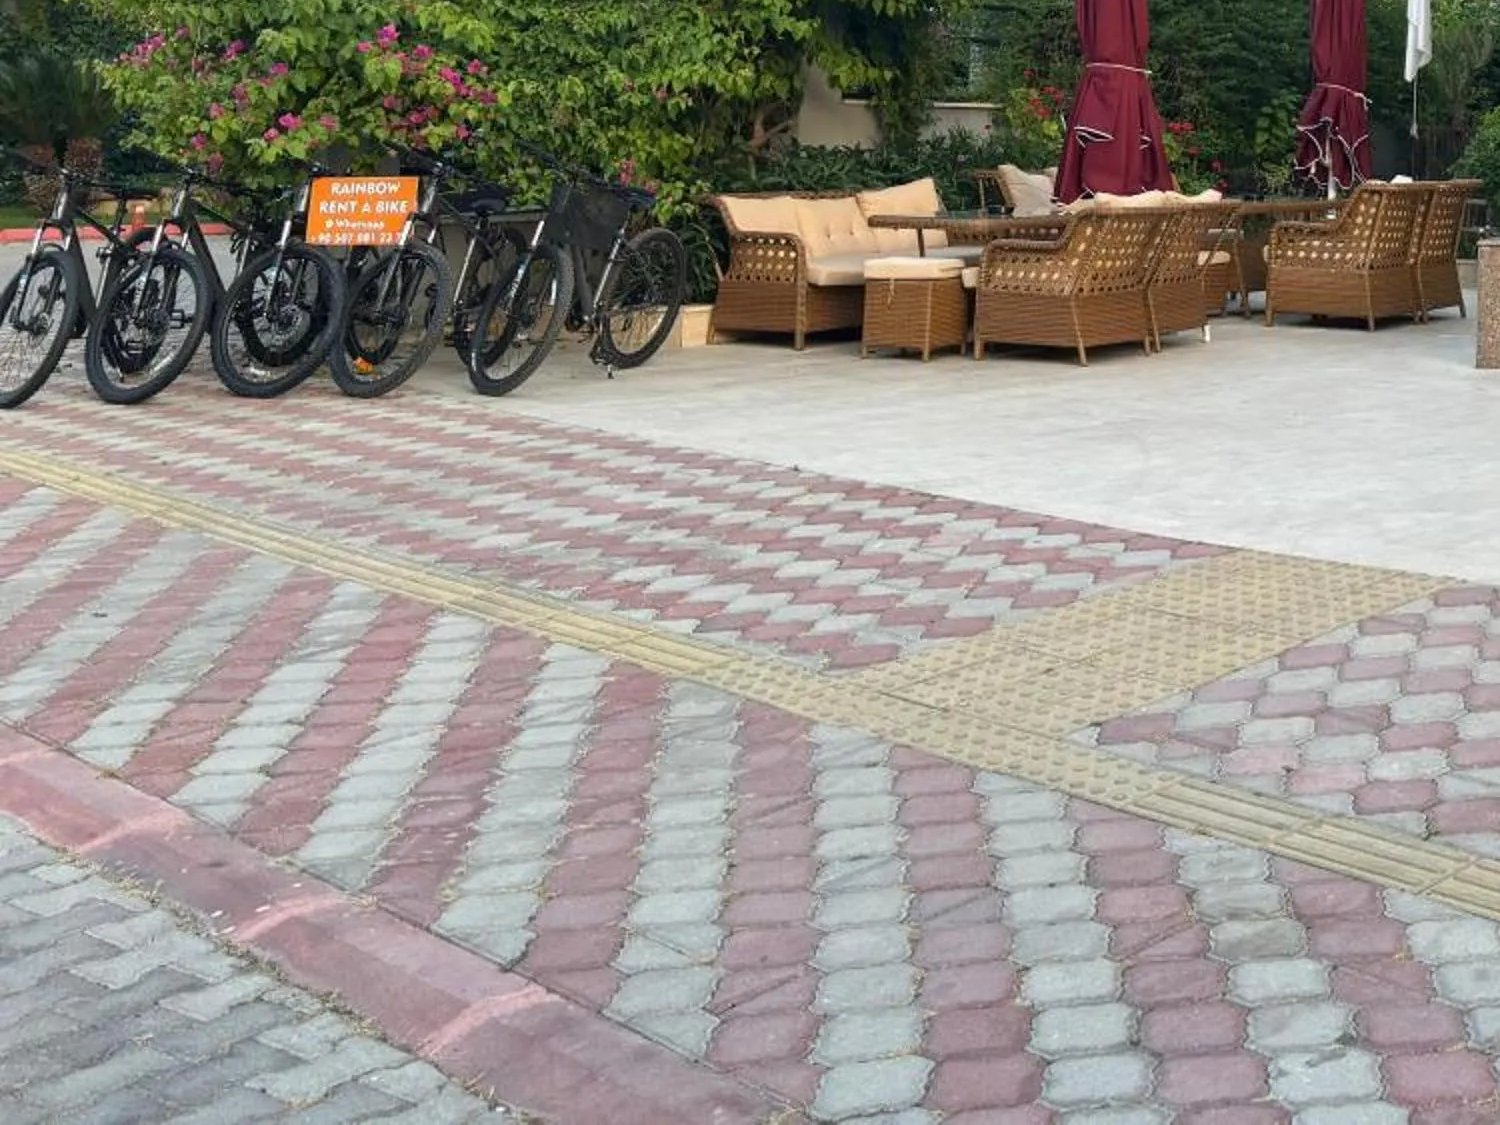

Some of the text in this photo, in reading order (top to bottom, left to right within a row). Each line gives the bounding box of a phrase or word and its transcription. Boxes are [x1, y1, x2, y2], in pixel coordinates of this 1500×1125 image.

[331, 182, 401, 195] RAINBOW
[320, 200, 409, 214] RENT A BIKE
